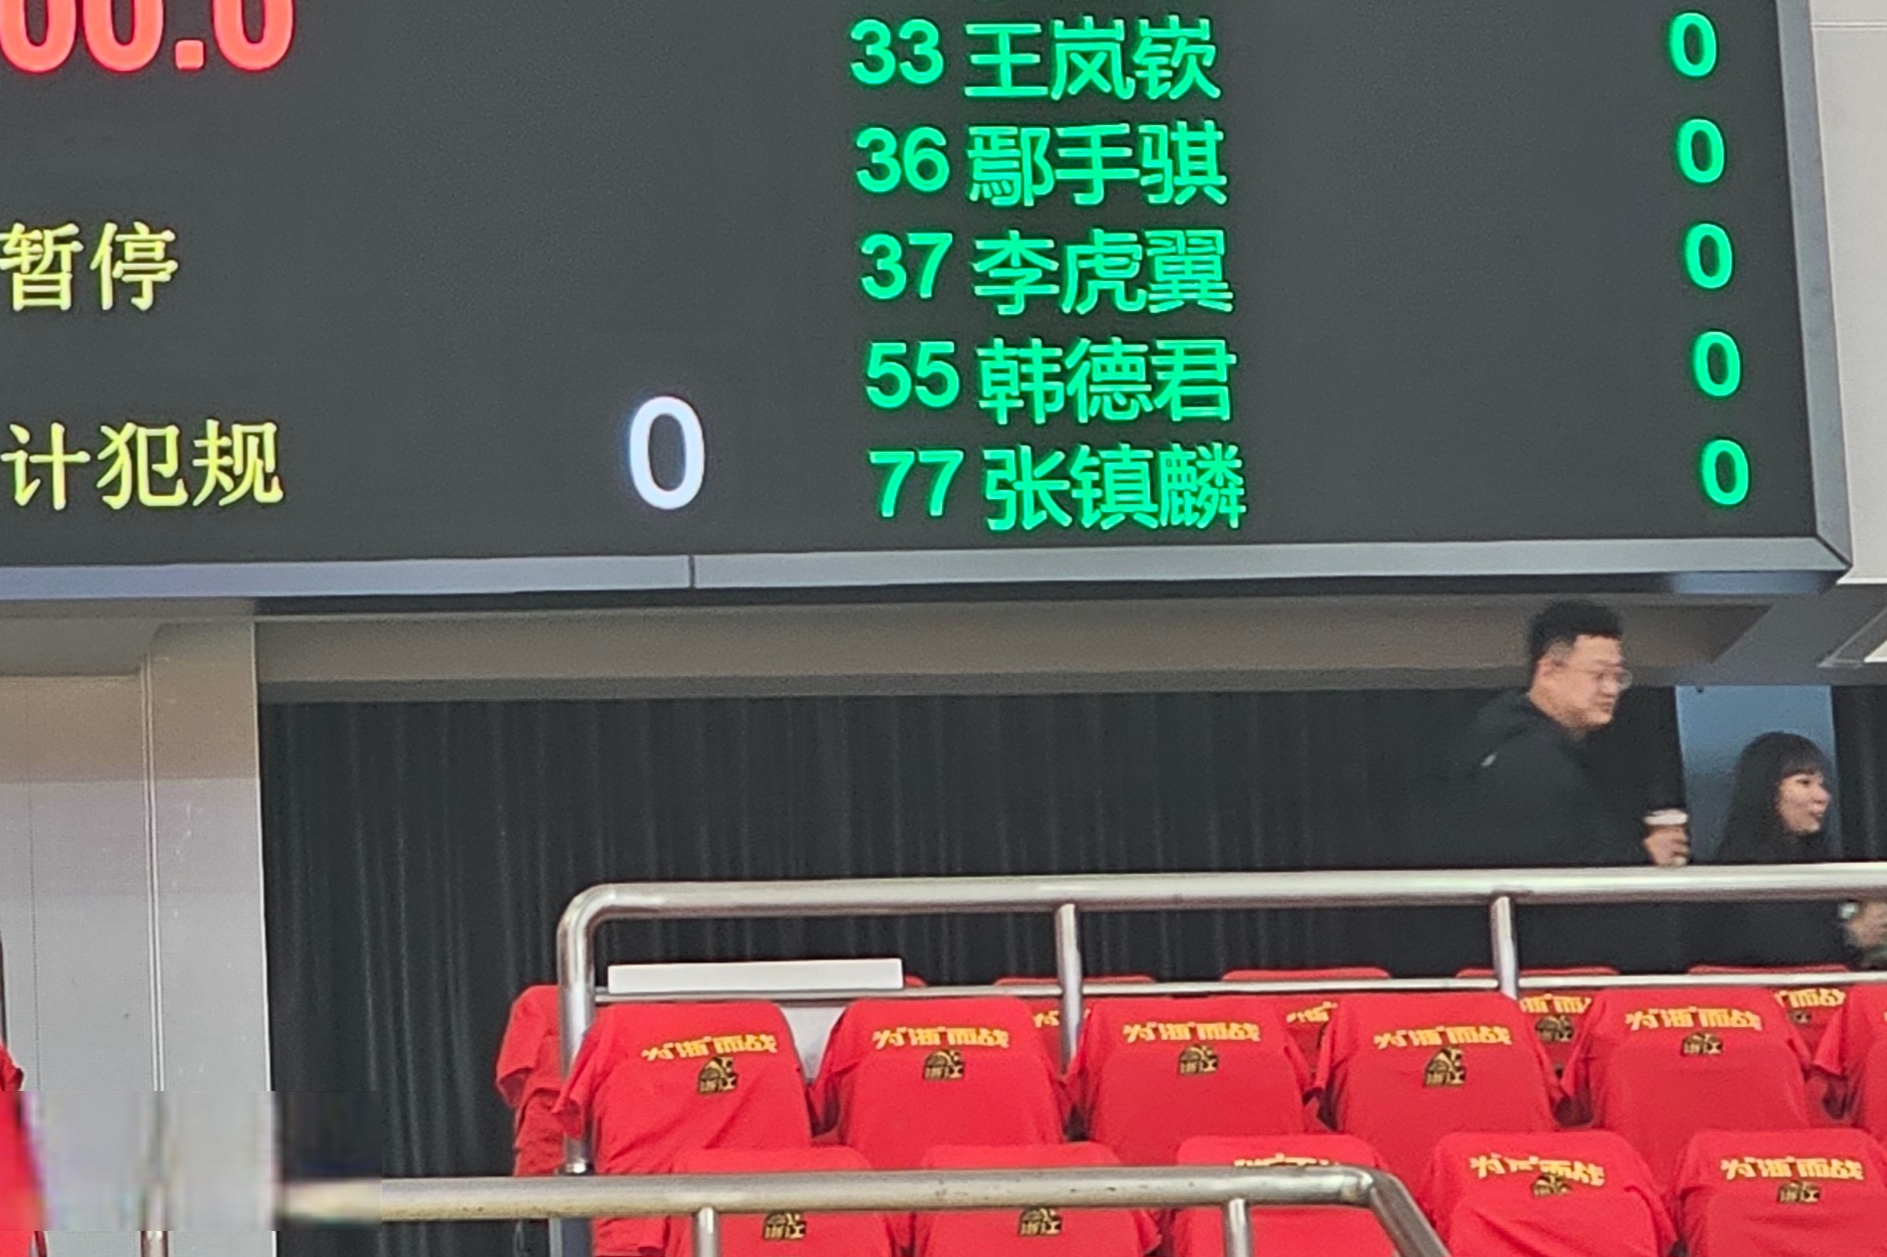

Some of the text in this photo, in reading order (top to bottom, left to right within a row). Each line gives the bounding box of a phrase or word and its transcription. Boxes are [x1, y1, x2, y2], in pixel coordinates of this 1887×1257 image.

[848, 10, 1719, 103] 33 王岚嵚 0
[853, 116, 1727, 209] 36 鄢手骐 0
[858, 222, 1735, 318] 37 李虎翼 0
[864, 330, 1743, 427] 55 韩德君 0
[626, 394, 707, 512] 0
[866, 437, 1751, 533] 77 张镇麟 0
